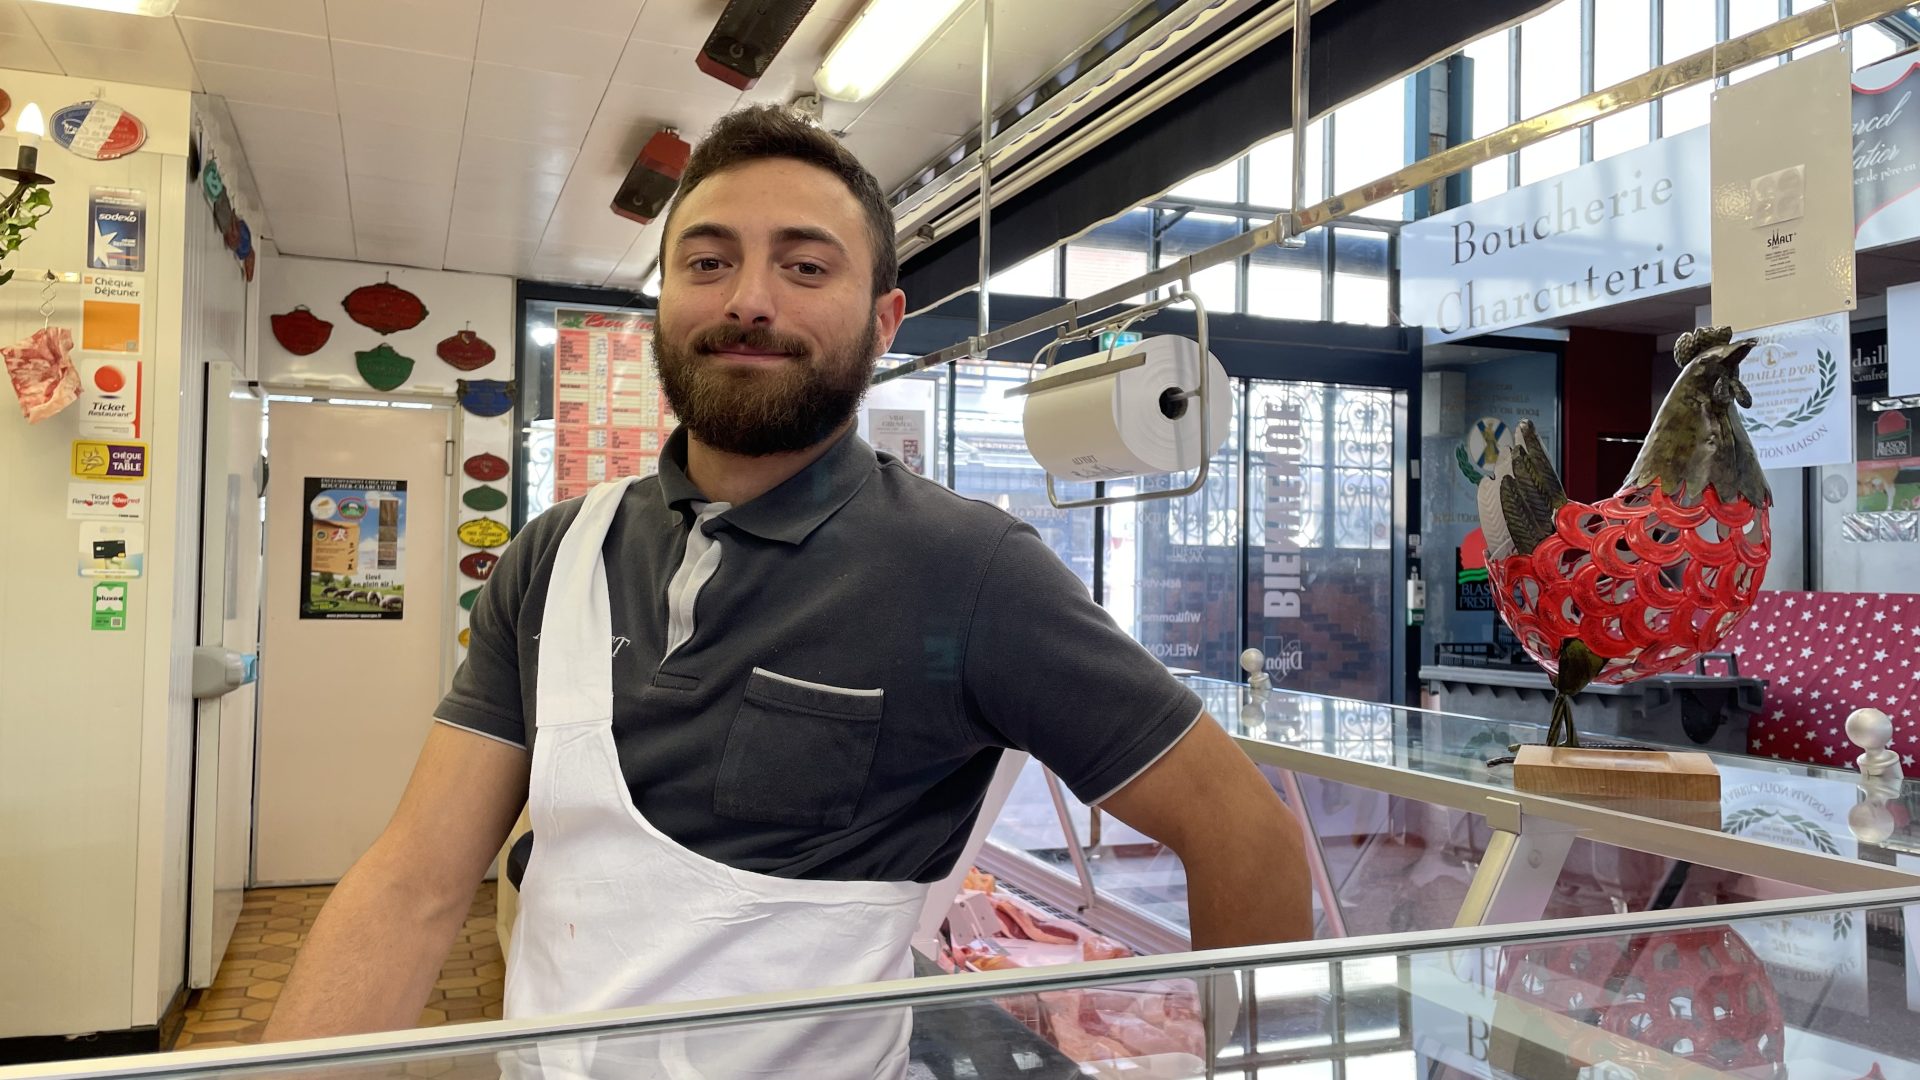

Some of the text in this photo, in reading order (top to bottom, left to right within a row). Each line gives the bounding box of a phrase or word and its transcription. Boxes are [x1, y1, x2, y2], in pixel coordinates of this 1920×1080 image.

[98, 211, 138, 223] sodexo
[1451, 169, 1673, 267] Boucherie
[1767, 229, 1793, 248] SMALT
[94, 276, 134, 288] Chèque
[94, 287, 140, 297] Déjeuner
[1436, 243, 1696, 335] Charcuterie
[1741, 368, 1787, 381] EDAILLE
[93, 402, 127, 412] Ticket
[88, 410, 131, 418] Restaurant
[1785, 424, 1829, 455] MAISON
[112, 462, 142, 472] TABLE
[1461, 583, 1491, 596] BLAS
